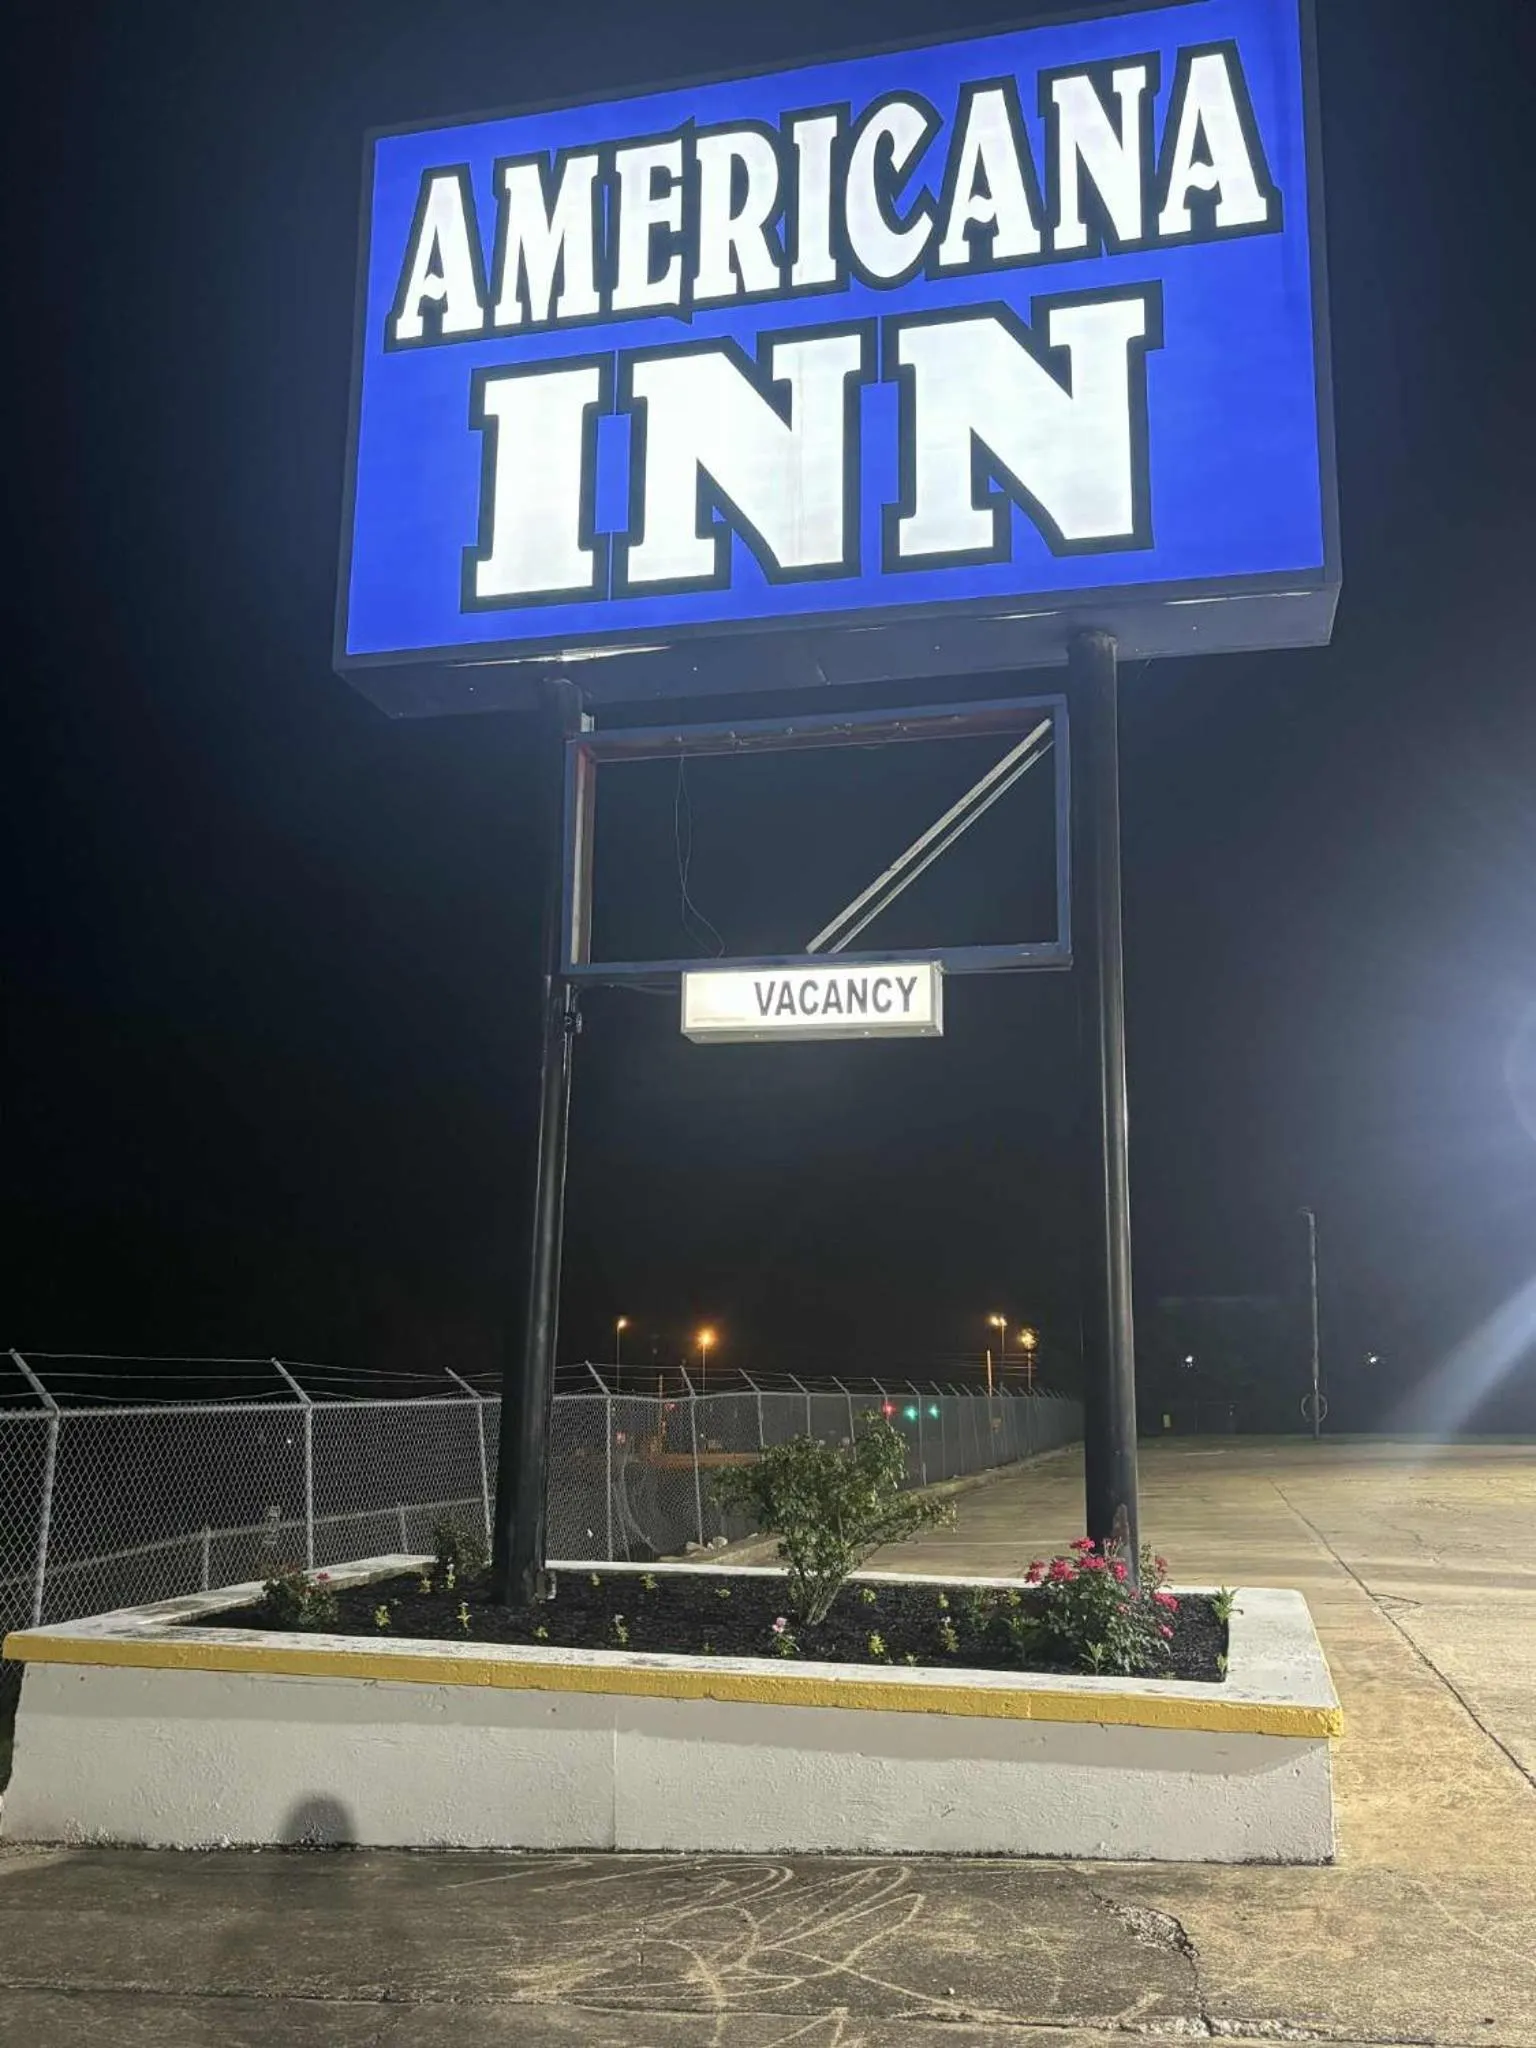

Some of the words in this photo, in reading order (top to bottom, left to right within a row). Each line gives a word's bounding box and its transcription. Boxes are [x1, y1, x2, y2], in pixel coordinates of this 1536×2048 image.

[392, 51, 1271, 342] AMERICANA
[473, 296, 1149, 602] INN
[753, 976, 918, 1016] VACANCY
